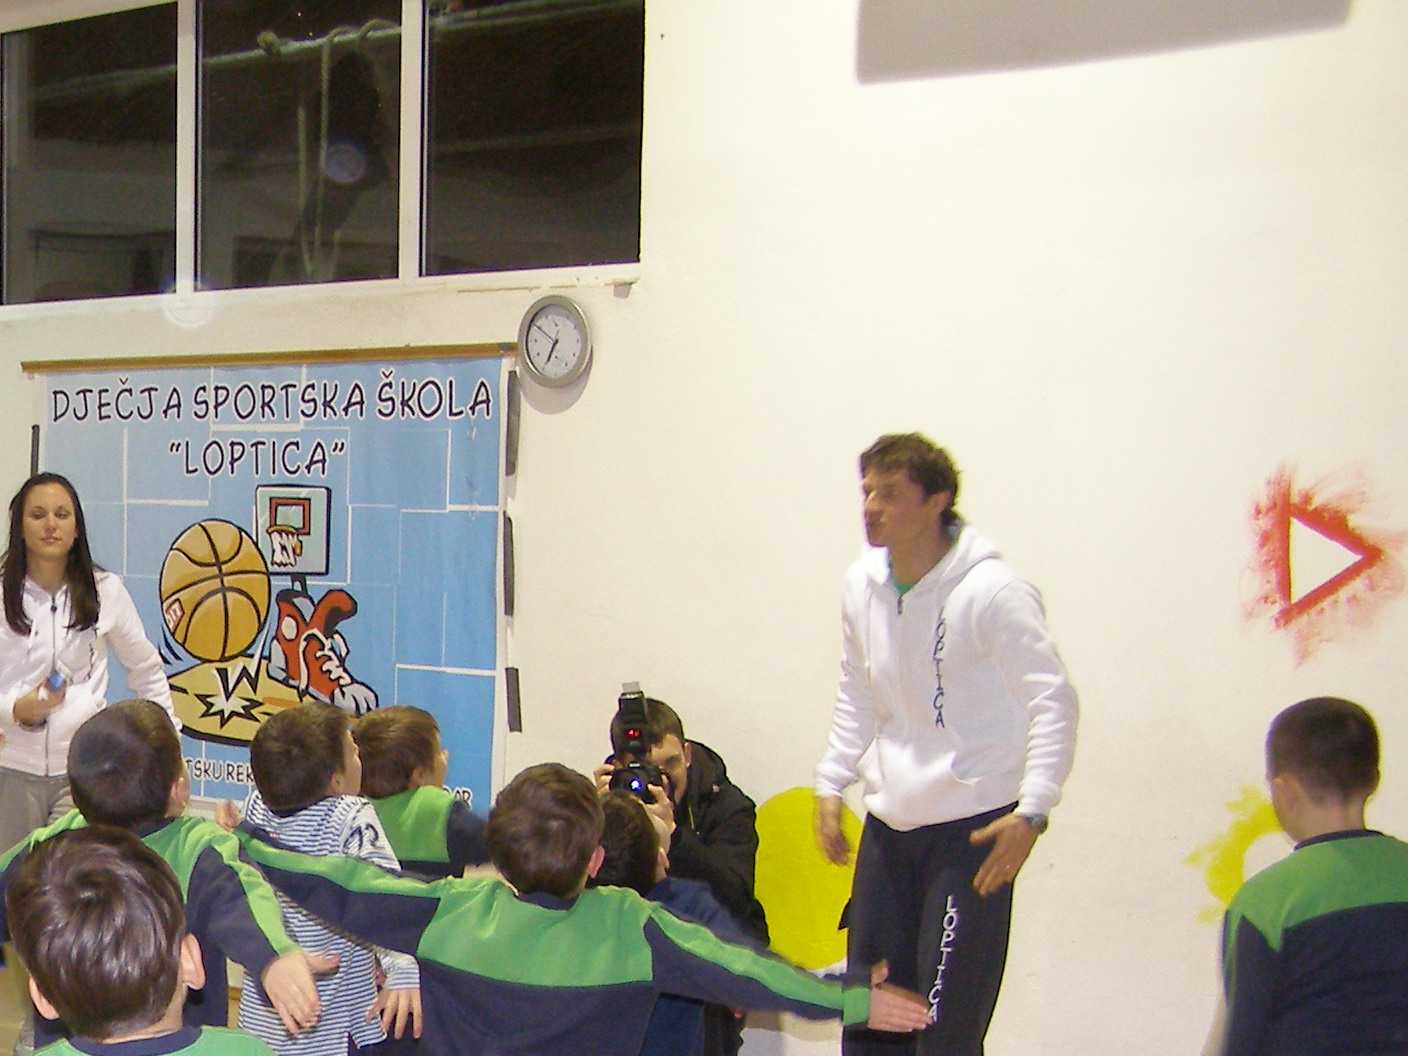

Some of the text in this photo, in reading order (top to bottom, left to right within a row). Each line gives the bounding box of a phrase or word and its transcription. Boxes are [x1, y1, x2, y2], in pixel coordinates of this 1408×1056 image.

[51, 370, 492, 422] DJEČJA SPORTSKA ŠKOLA
[186, 759, 223, 781] TSKU
[226, 763, 254, 783] REK
[928, 895, 958, 1023] LOPTICA
